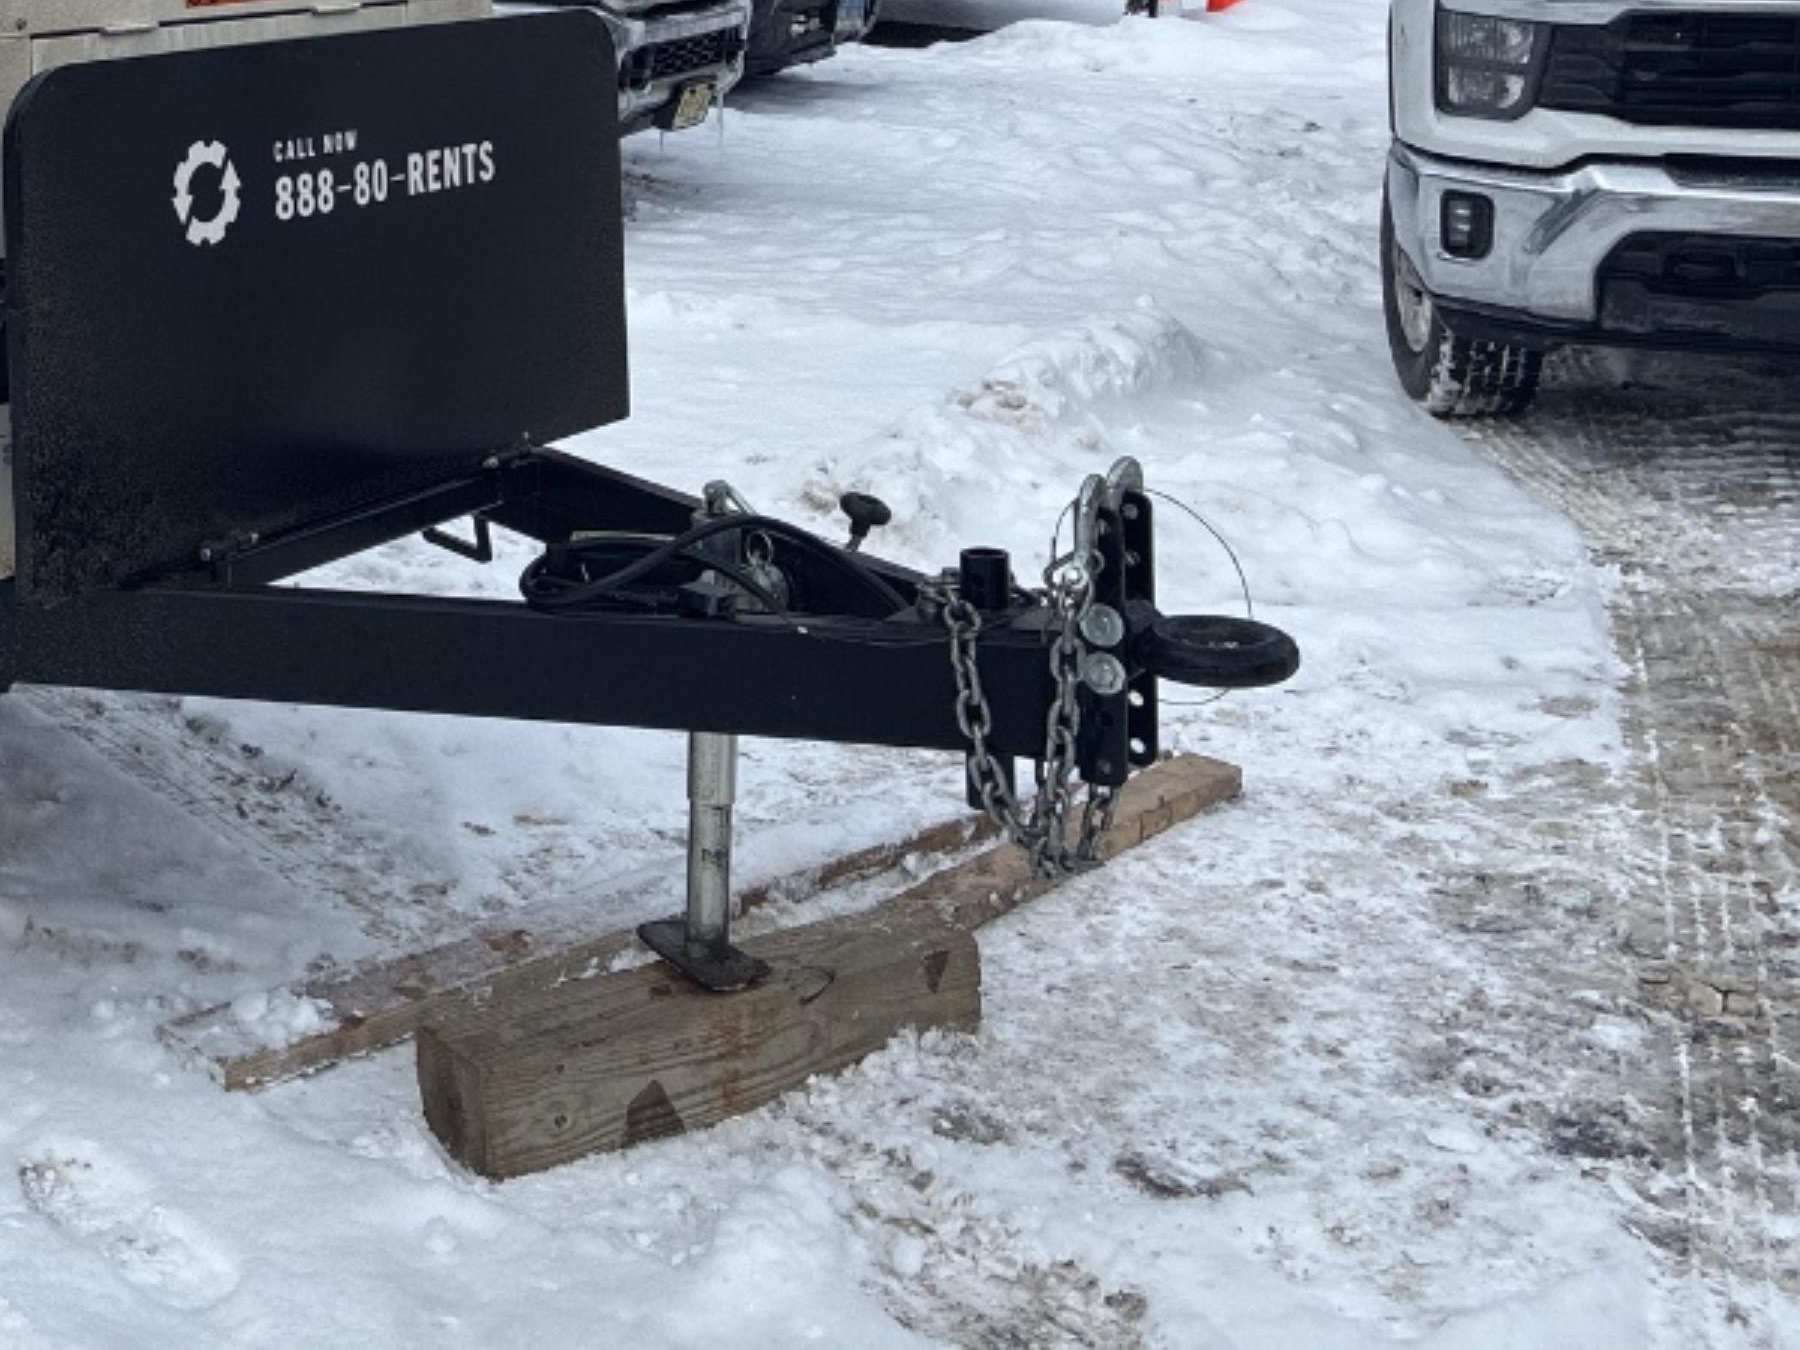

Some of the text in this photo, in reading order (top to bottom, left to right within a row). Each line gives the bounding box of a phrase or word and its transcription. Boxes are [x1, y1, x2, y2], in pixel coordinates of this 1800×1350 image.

[273, 129, 359, 162] CALL NOW
[275, 139, 496, 221] 888-80-RENTS
